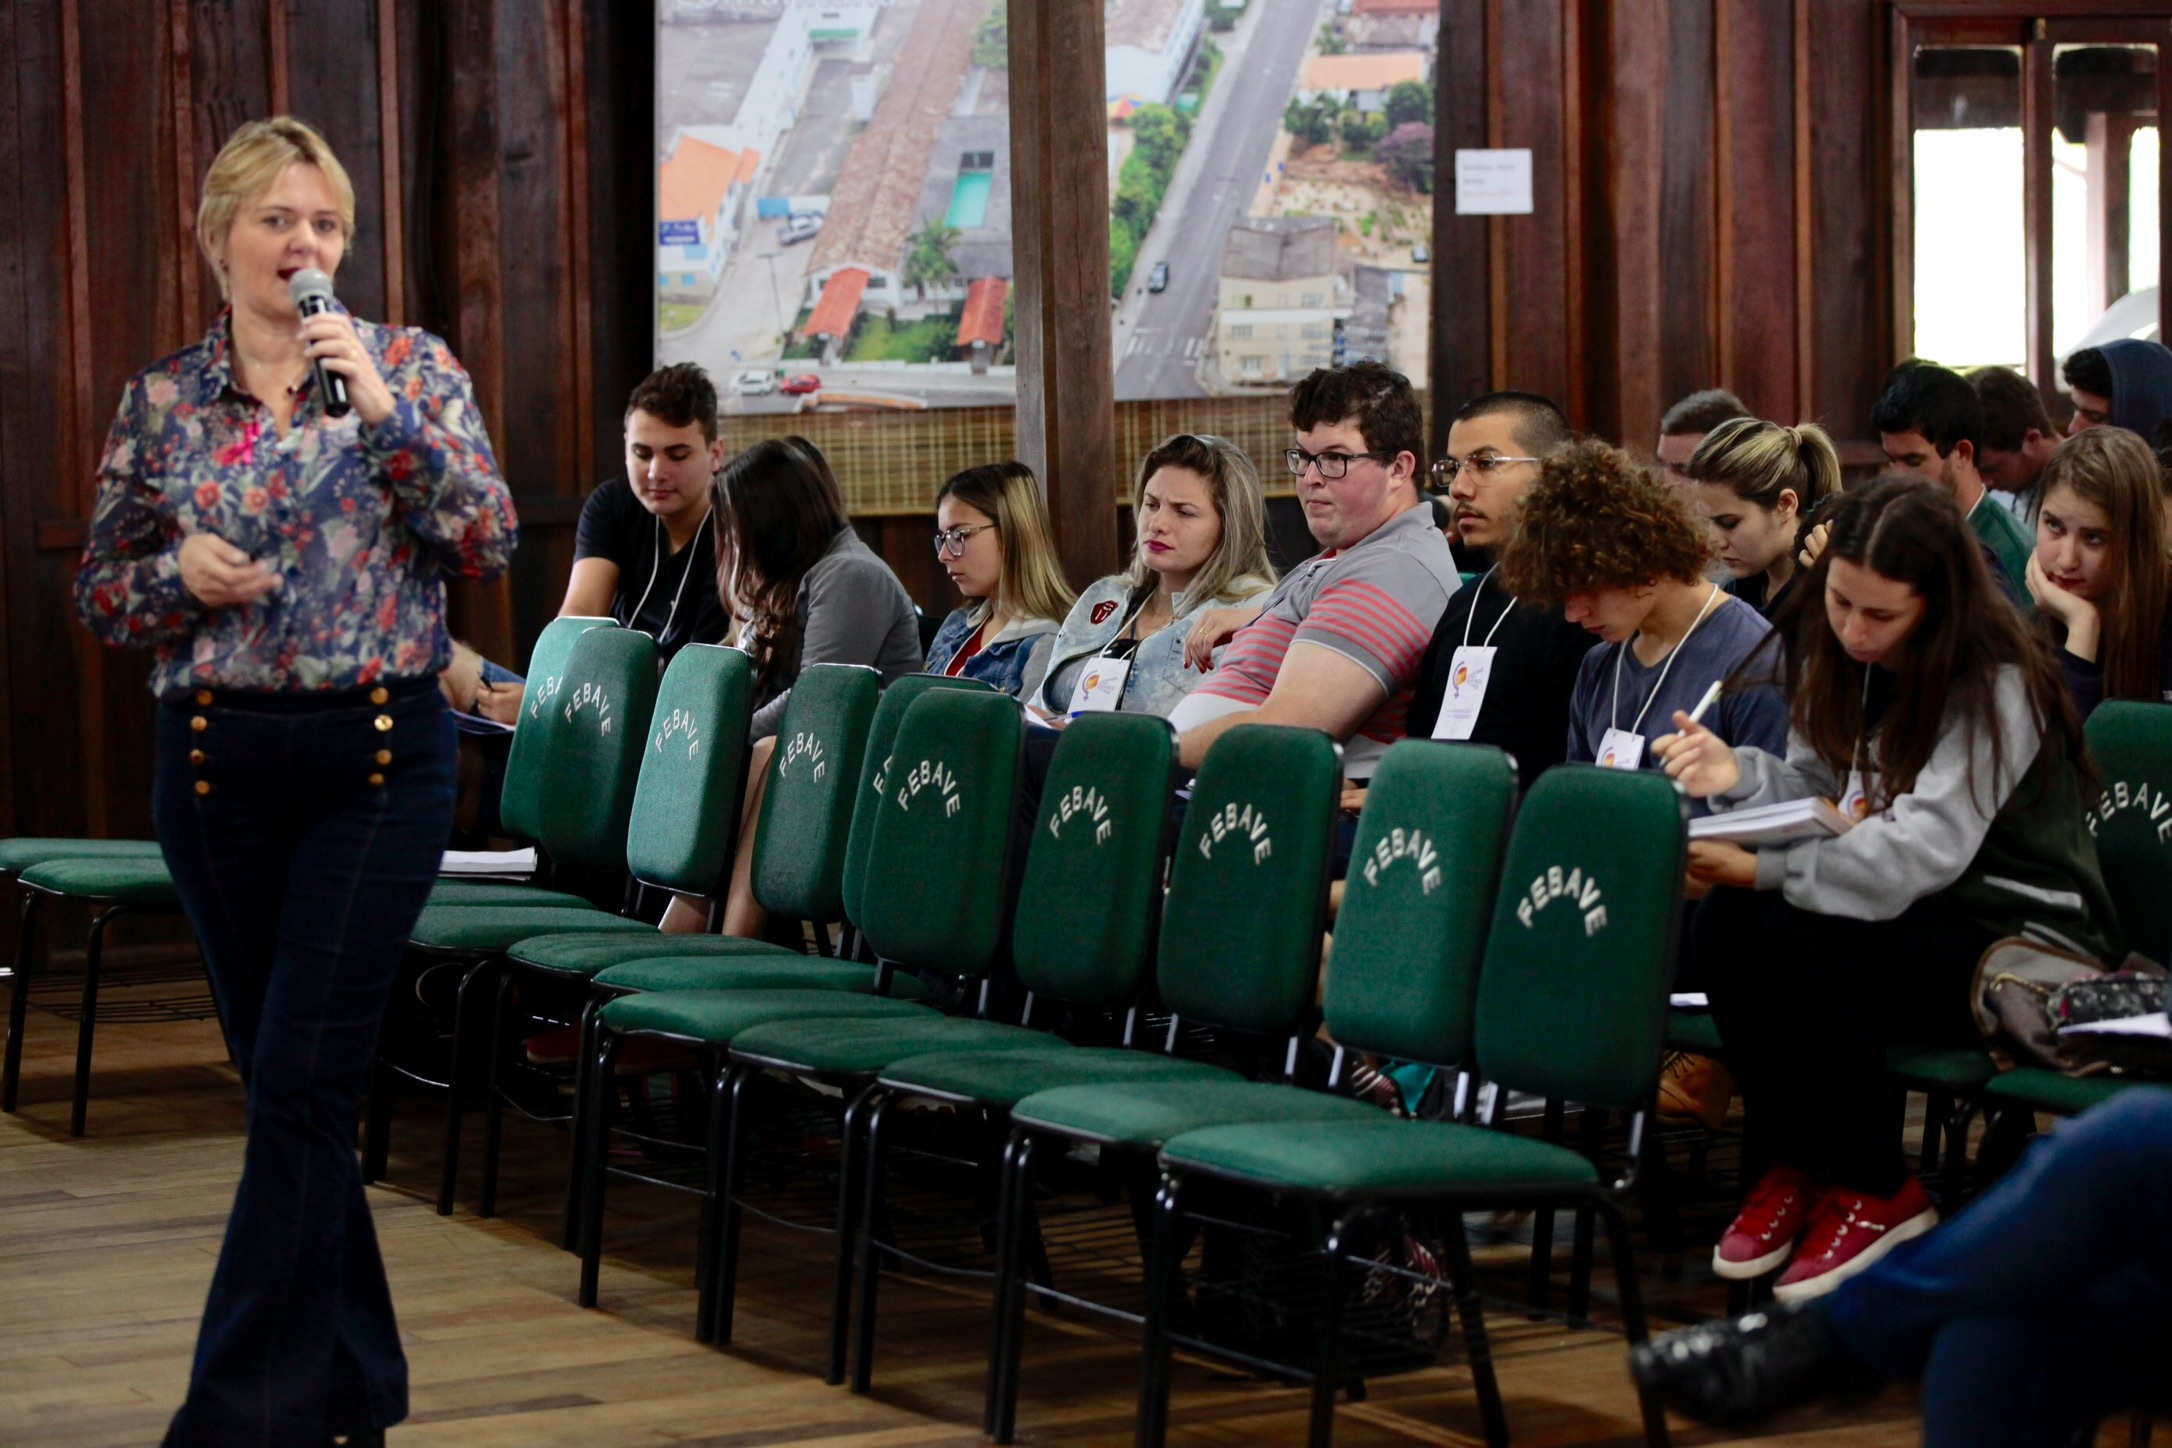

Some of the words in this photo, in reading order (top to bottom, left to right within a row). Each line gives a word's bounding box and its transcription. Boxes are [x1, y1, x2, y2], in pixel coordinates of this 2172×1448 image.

[564, 682, 611, 737] FEBAVE
[655, 708, 699, 760] FEBAVE
[779, 731, 825, 783] FEBAVE
[897, 760, 961, 818] FEBAVE
[1049, 785, 1111, 844] FEBAVE
[1199, 802, 1271, 865] FEBAVE
[1363, 827, 1441, 895] FEBAVE
[1517, 866, 1607, 936] FEBAVE
